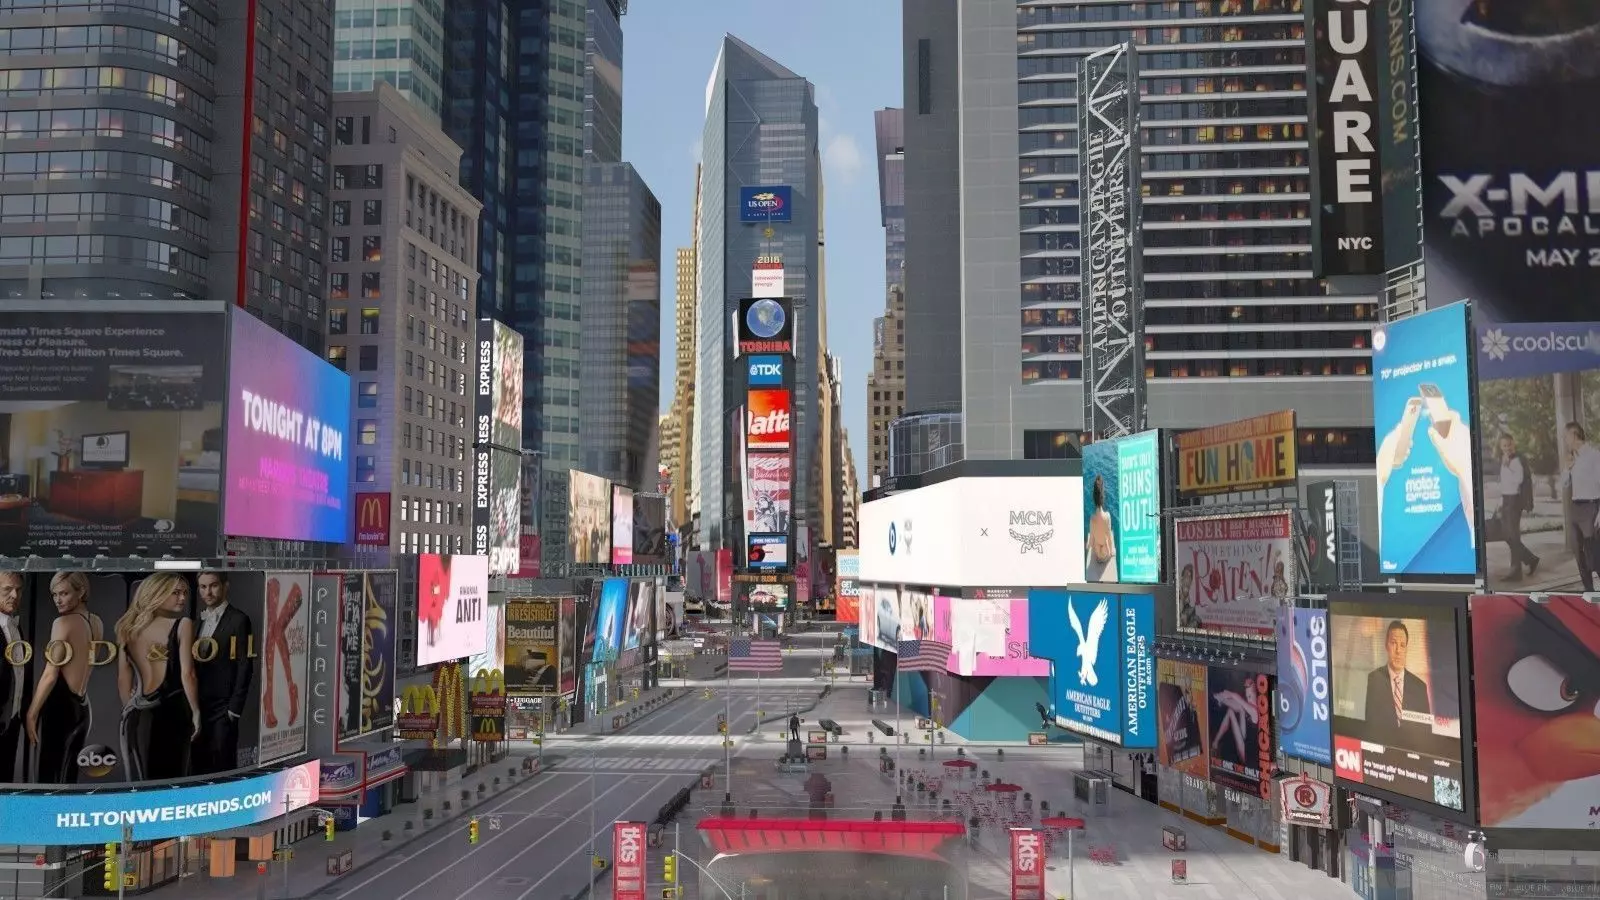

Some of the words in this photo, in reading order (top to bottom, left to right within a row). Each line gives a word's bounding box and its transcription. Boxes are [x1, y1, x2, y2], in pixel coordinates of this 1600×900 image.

[1328, 0, 1375, 203] UARE
[1338, 237, 1372, 250] NYC
[1526, 249, 1580, 267] MAY
[30, 327, 62, 336] Times
[64, 327, 102, 338] Square
[104, 327, 165, 338] Experience
[57, 348, 71, 360] by
[73, 348, 106, 357] Hilton
[108, 348, 140, 357] Times
[142, 348, 184, 360] Square.
[740, 340, 791, 352] TOSHIBA
[479, 341, 490, 395] EXPRESS
[757, 364, 781, 376] TDK
[242, 390, 303, 445] TONIGHT
[305, 417, 321, 452] AT
[321, 423, 342, 462] 8PM
[1186, 447, 1219, 486] FUN
[478, 453, 489, 508] EXPRESS
[1122, 469, 1152, 498] BUNS
[1009, 511, 1053, 525] MCM
[1178, 519, 1227, 540] LOSER!
[1324, 487, 1336, 564] NEW
[456, 598, 481, 624] ANTI
[507, 624, 555, 640] Beautiful
[1126, 607, 1136, 659] EAGLE
[191, 634, 257, 664] OIL
[313, 587, 328, 724] PALACE
[1310, 616, 1327, 698] SOLO
[1136, 635, 1146, 709] OUTFITTERS
[1065, 689, 1092, 707] AMERICAN
[1127, 662, 1138, 736] AMERICAN
[1312, 701, 1328, 722] 2
[77, 752, 117, 768] abc
[1244, 767, 1260, 778] ONLY
[1335, 748, 1360, 773] CNN
[56, 790, 272, 828] HILTONWEEKENDS.COM
[621, 827, 641, 863] tkts
[1417, 832, 1428, 840] BLUE
[1018, 834, 1039, 872] tkts
[1566, 884, 1584, 892] BLUE
